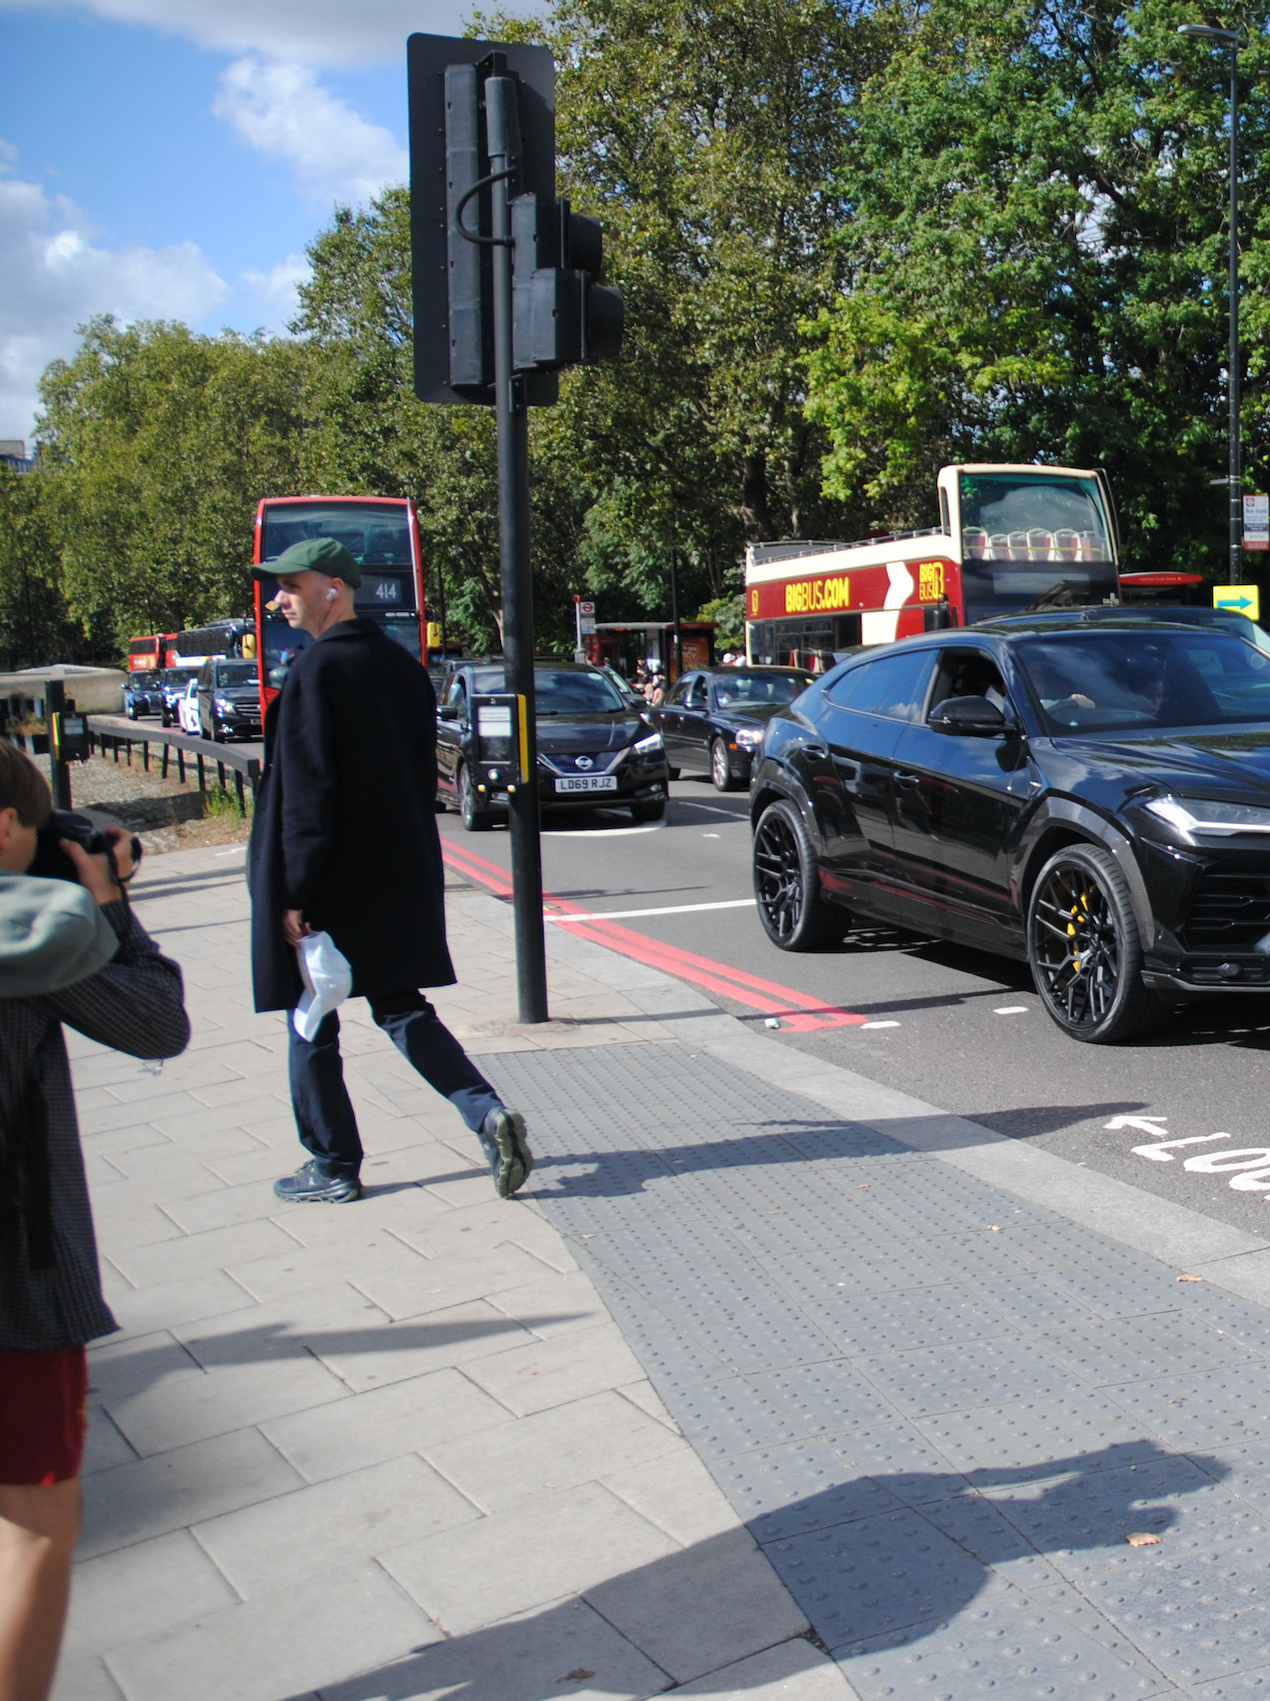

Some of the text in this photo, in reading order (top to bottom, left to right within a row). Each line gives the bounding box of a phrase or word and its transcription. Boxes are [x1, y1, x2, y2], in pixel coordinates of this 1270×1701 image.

[919, 562, 933, 583] BIG
[375, 583, 397, 599] 414
[785, 576, 850, 613] BIGBUS.COM
[919, 583, 933, 600] BUS
[560, 778, 612, 790] LD69 RJZ
